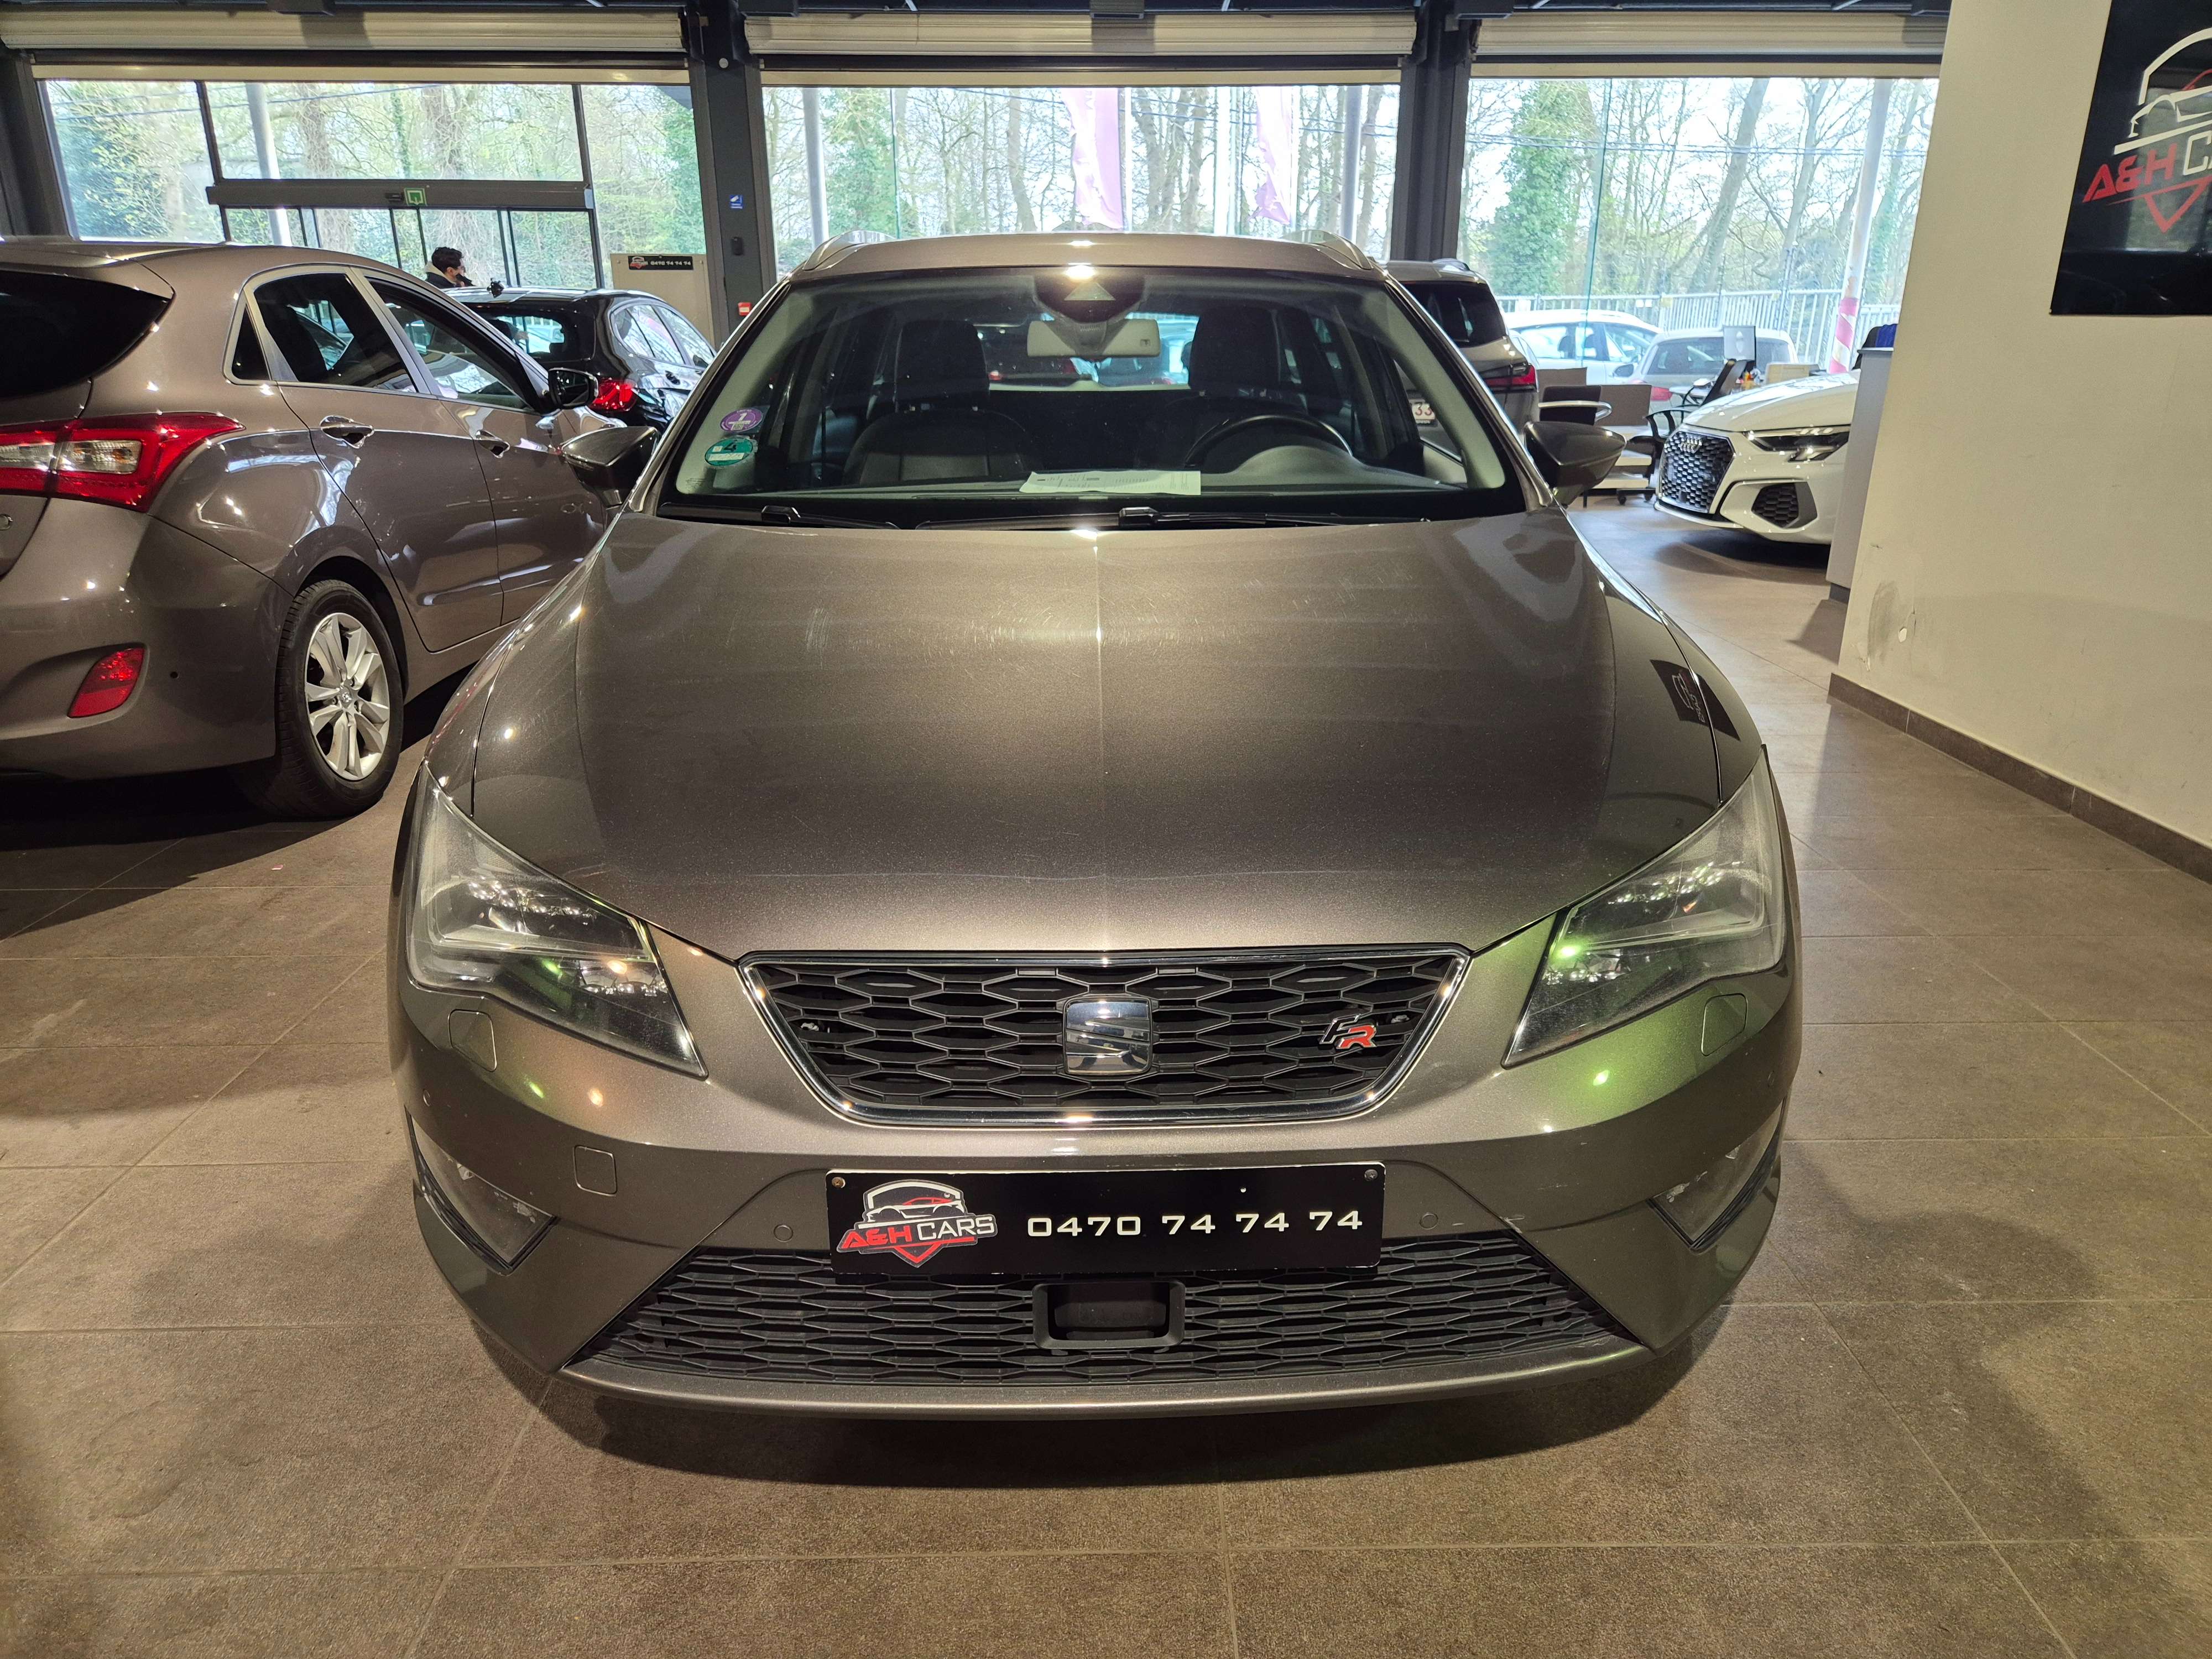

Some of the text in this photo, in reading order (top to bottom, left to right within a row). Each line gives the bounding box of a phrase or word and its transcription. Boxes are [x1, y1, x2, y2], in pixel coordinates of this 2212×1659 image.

[2082, 130, 2212, 203] A&H C
[841, 1216, 995, 1249] A&H CARS
[1027, 1211, 1363, 1237] 0470 74 74 74
